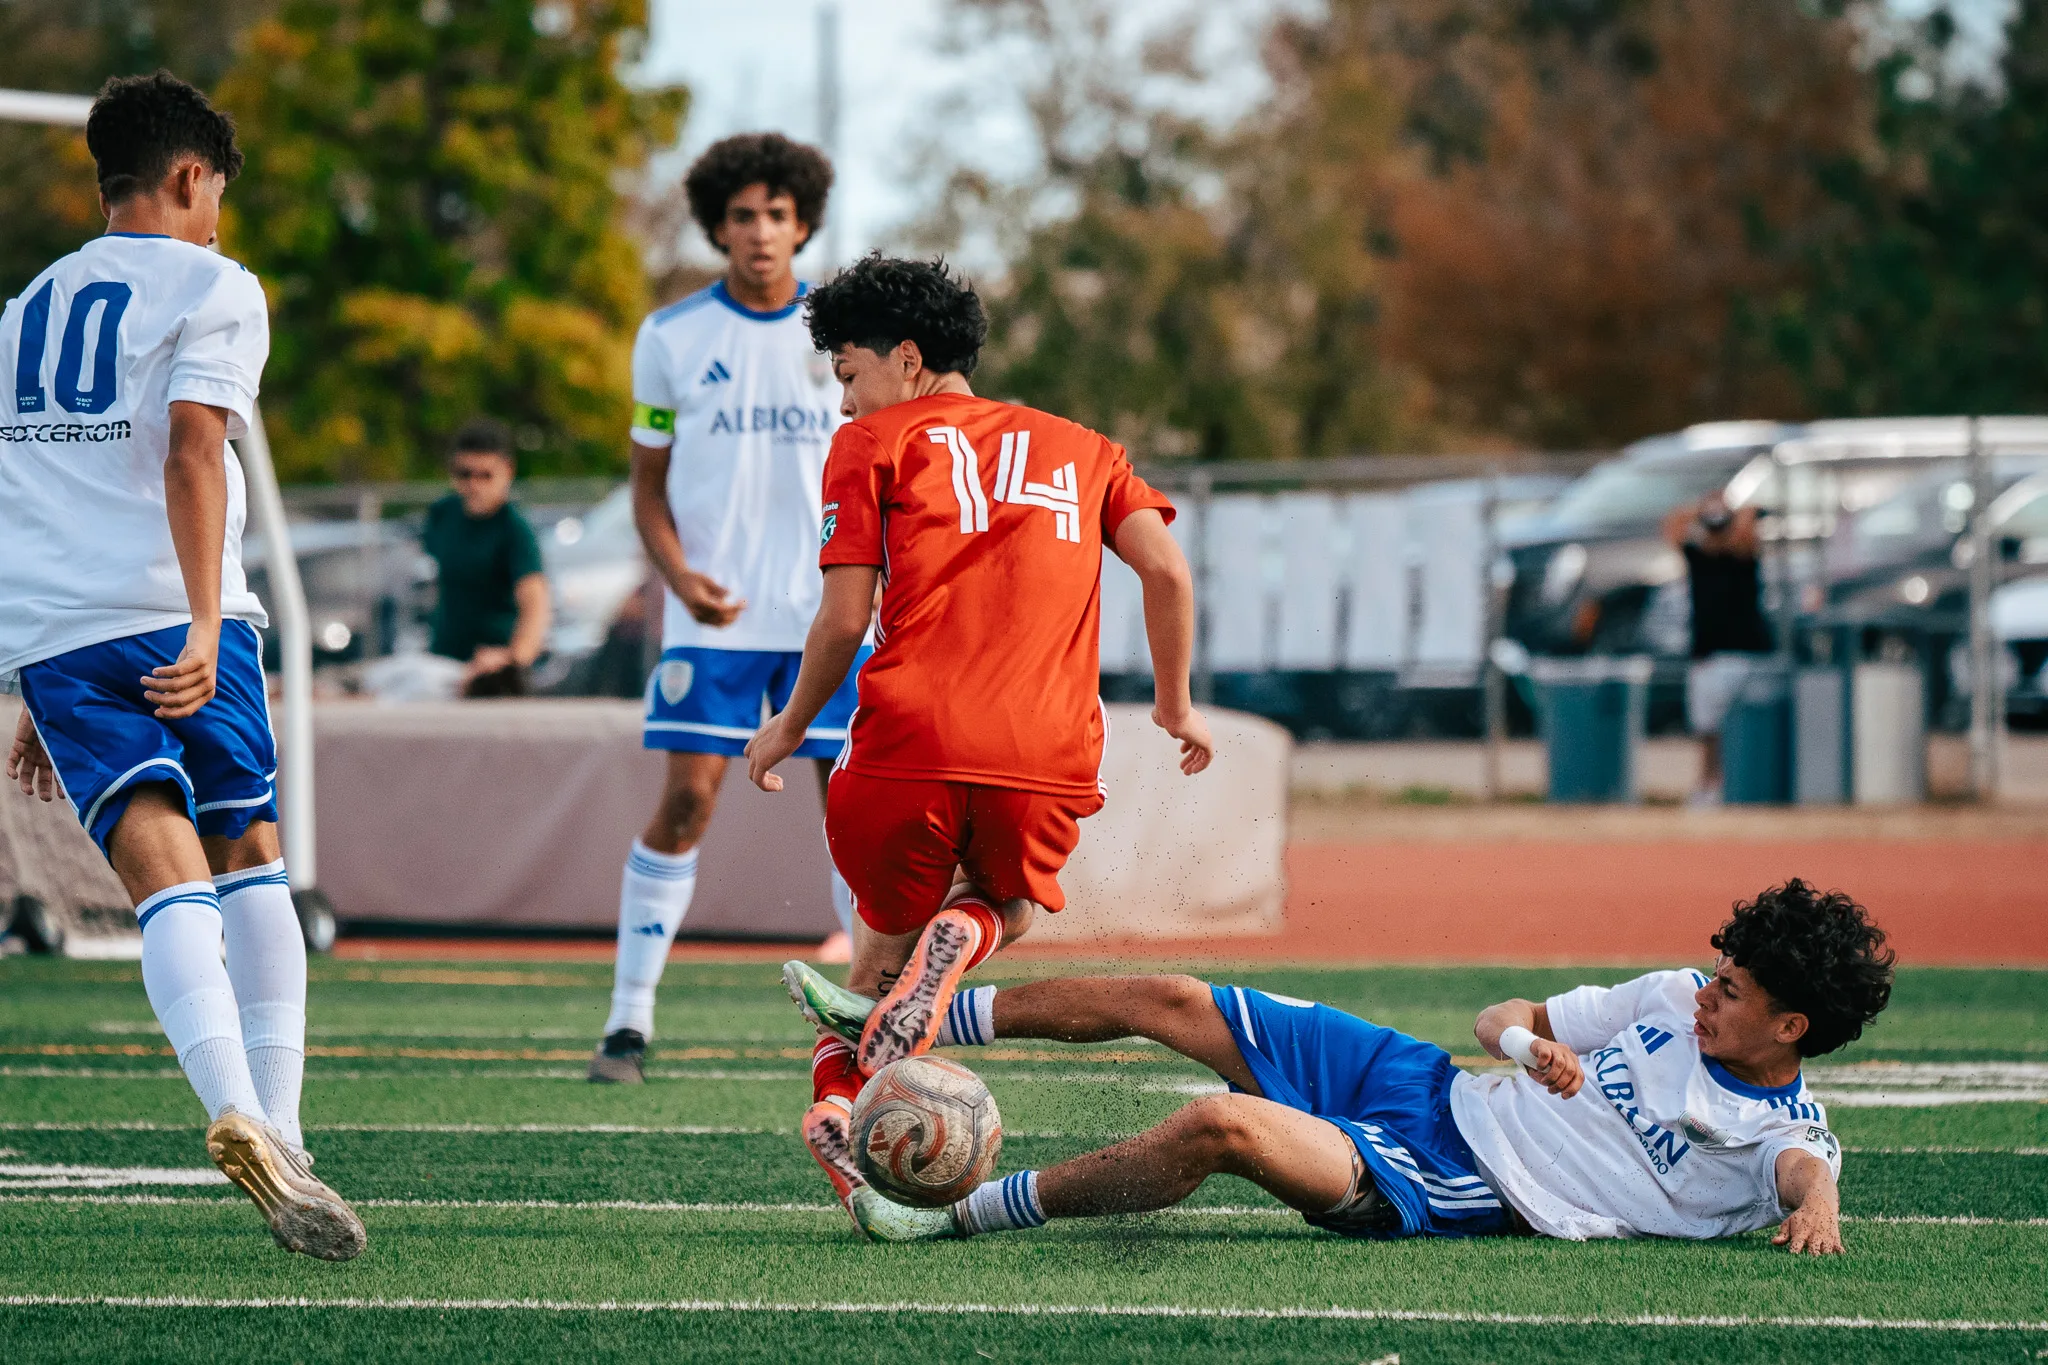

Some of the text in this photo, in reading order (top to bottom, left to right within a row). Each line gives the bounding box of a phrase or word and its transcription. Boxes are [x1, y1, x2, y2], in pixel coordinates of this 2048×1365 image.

[15, 277, 133, 415] 10
[709, 404, 831, 436] ALBION
[925, 426, 1081, 544] 14
